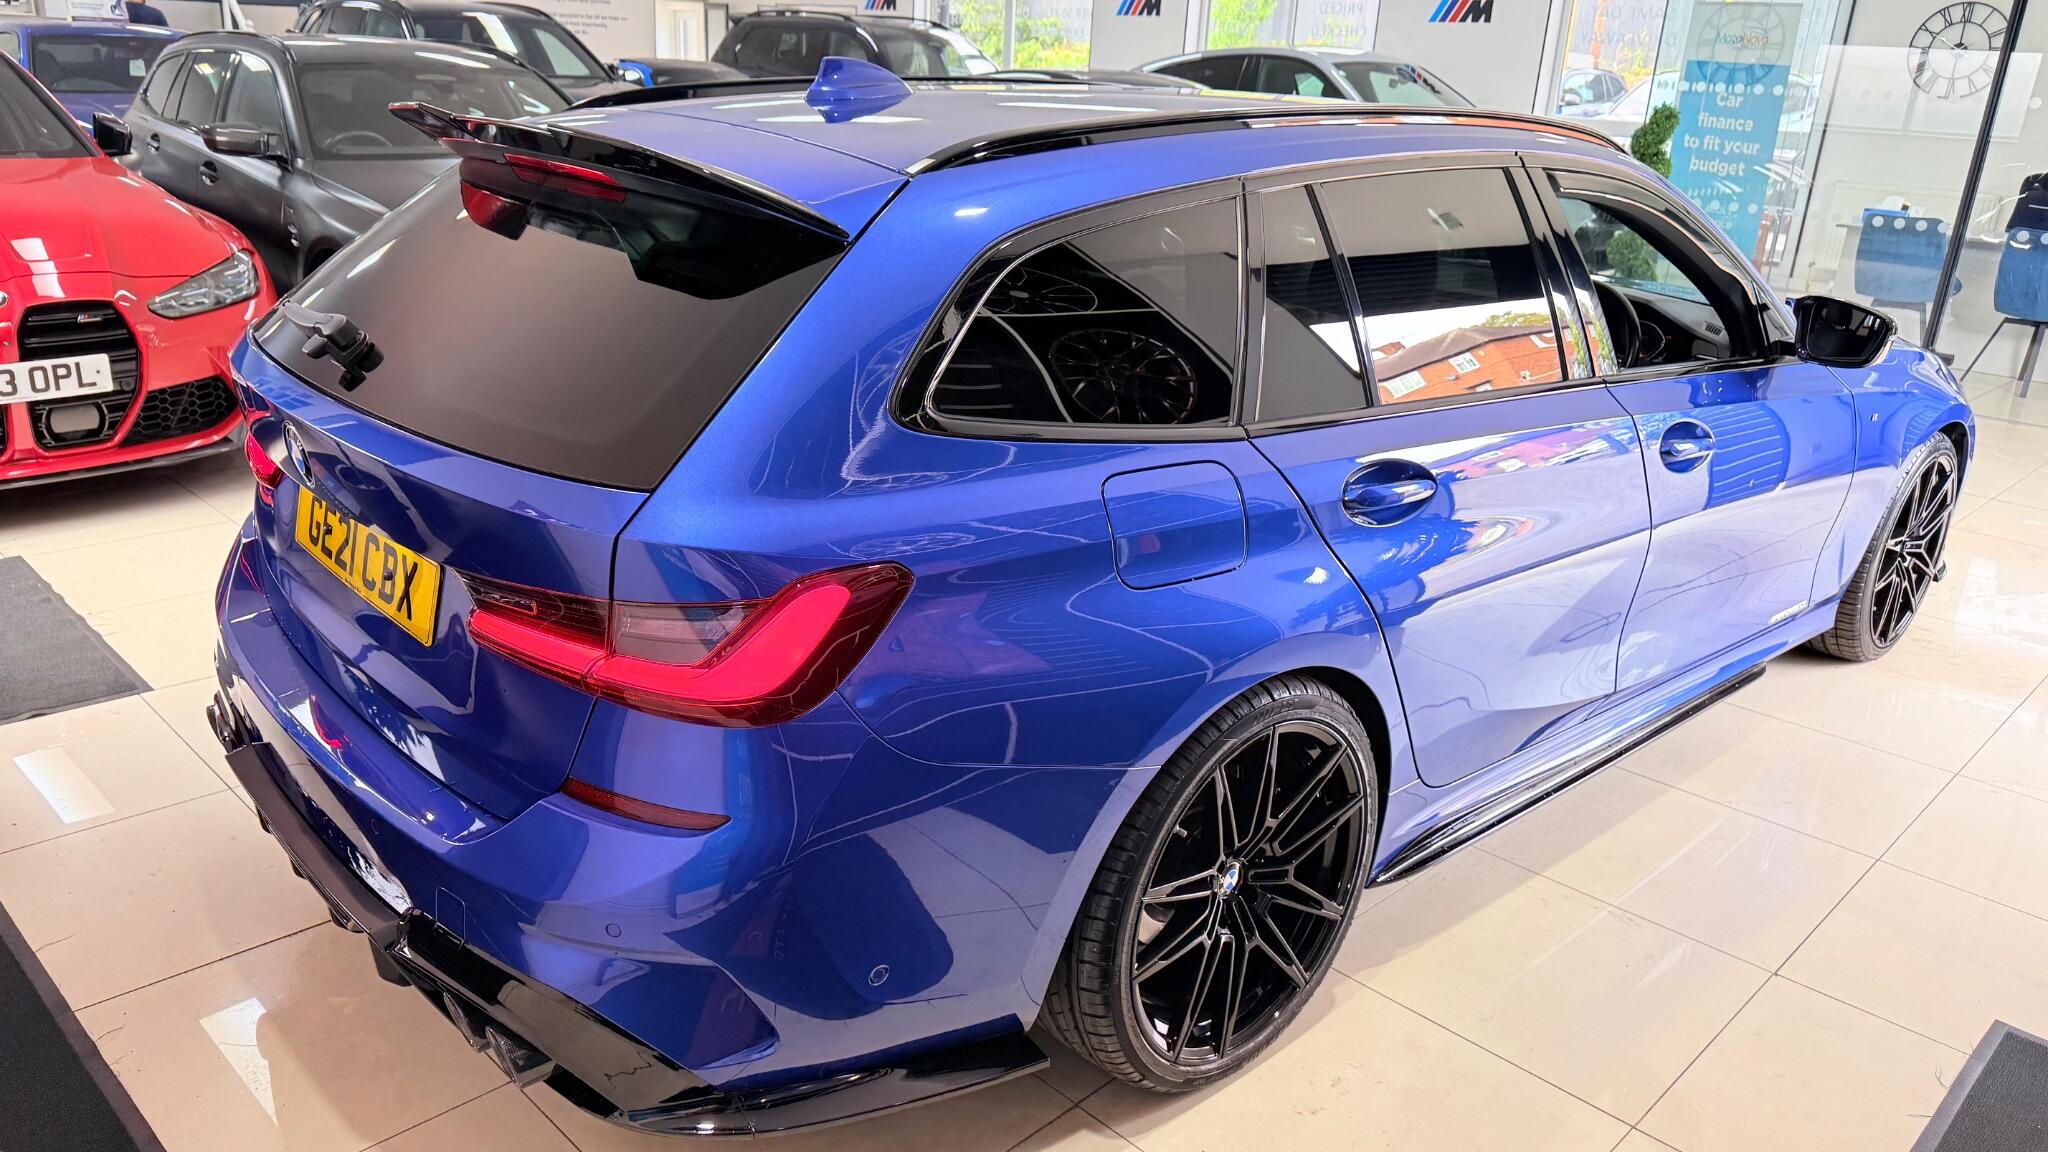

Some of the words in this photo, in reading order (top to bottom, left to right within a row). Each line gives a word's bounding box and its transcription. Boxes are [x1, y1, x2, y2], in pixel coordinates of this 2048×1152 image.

[1716, 92, 1744, 108] Car
[1697, 112, 1754, 132] finance
[1683, 133, 1700, 148] to
[1703, 135, 1720, 151] fit
[1724, 141, 1761, 155] your
[1688, 155, 1745, 176] budget
[28, 362, 97, 394] OPL
[308, 499, 359, 577] GE21
[362, 533, 419, 621] CBX
